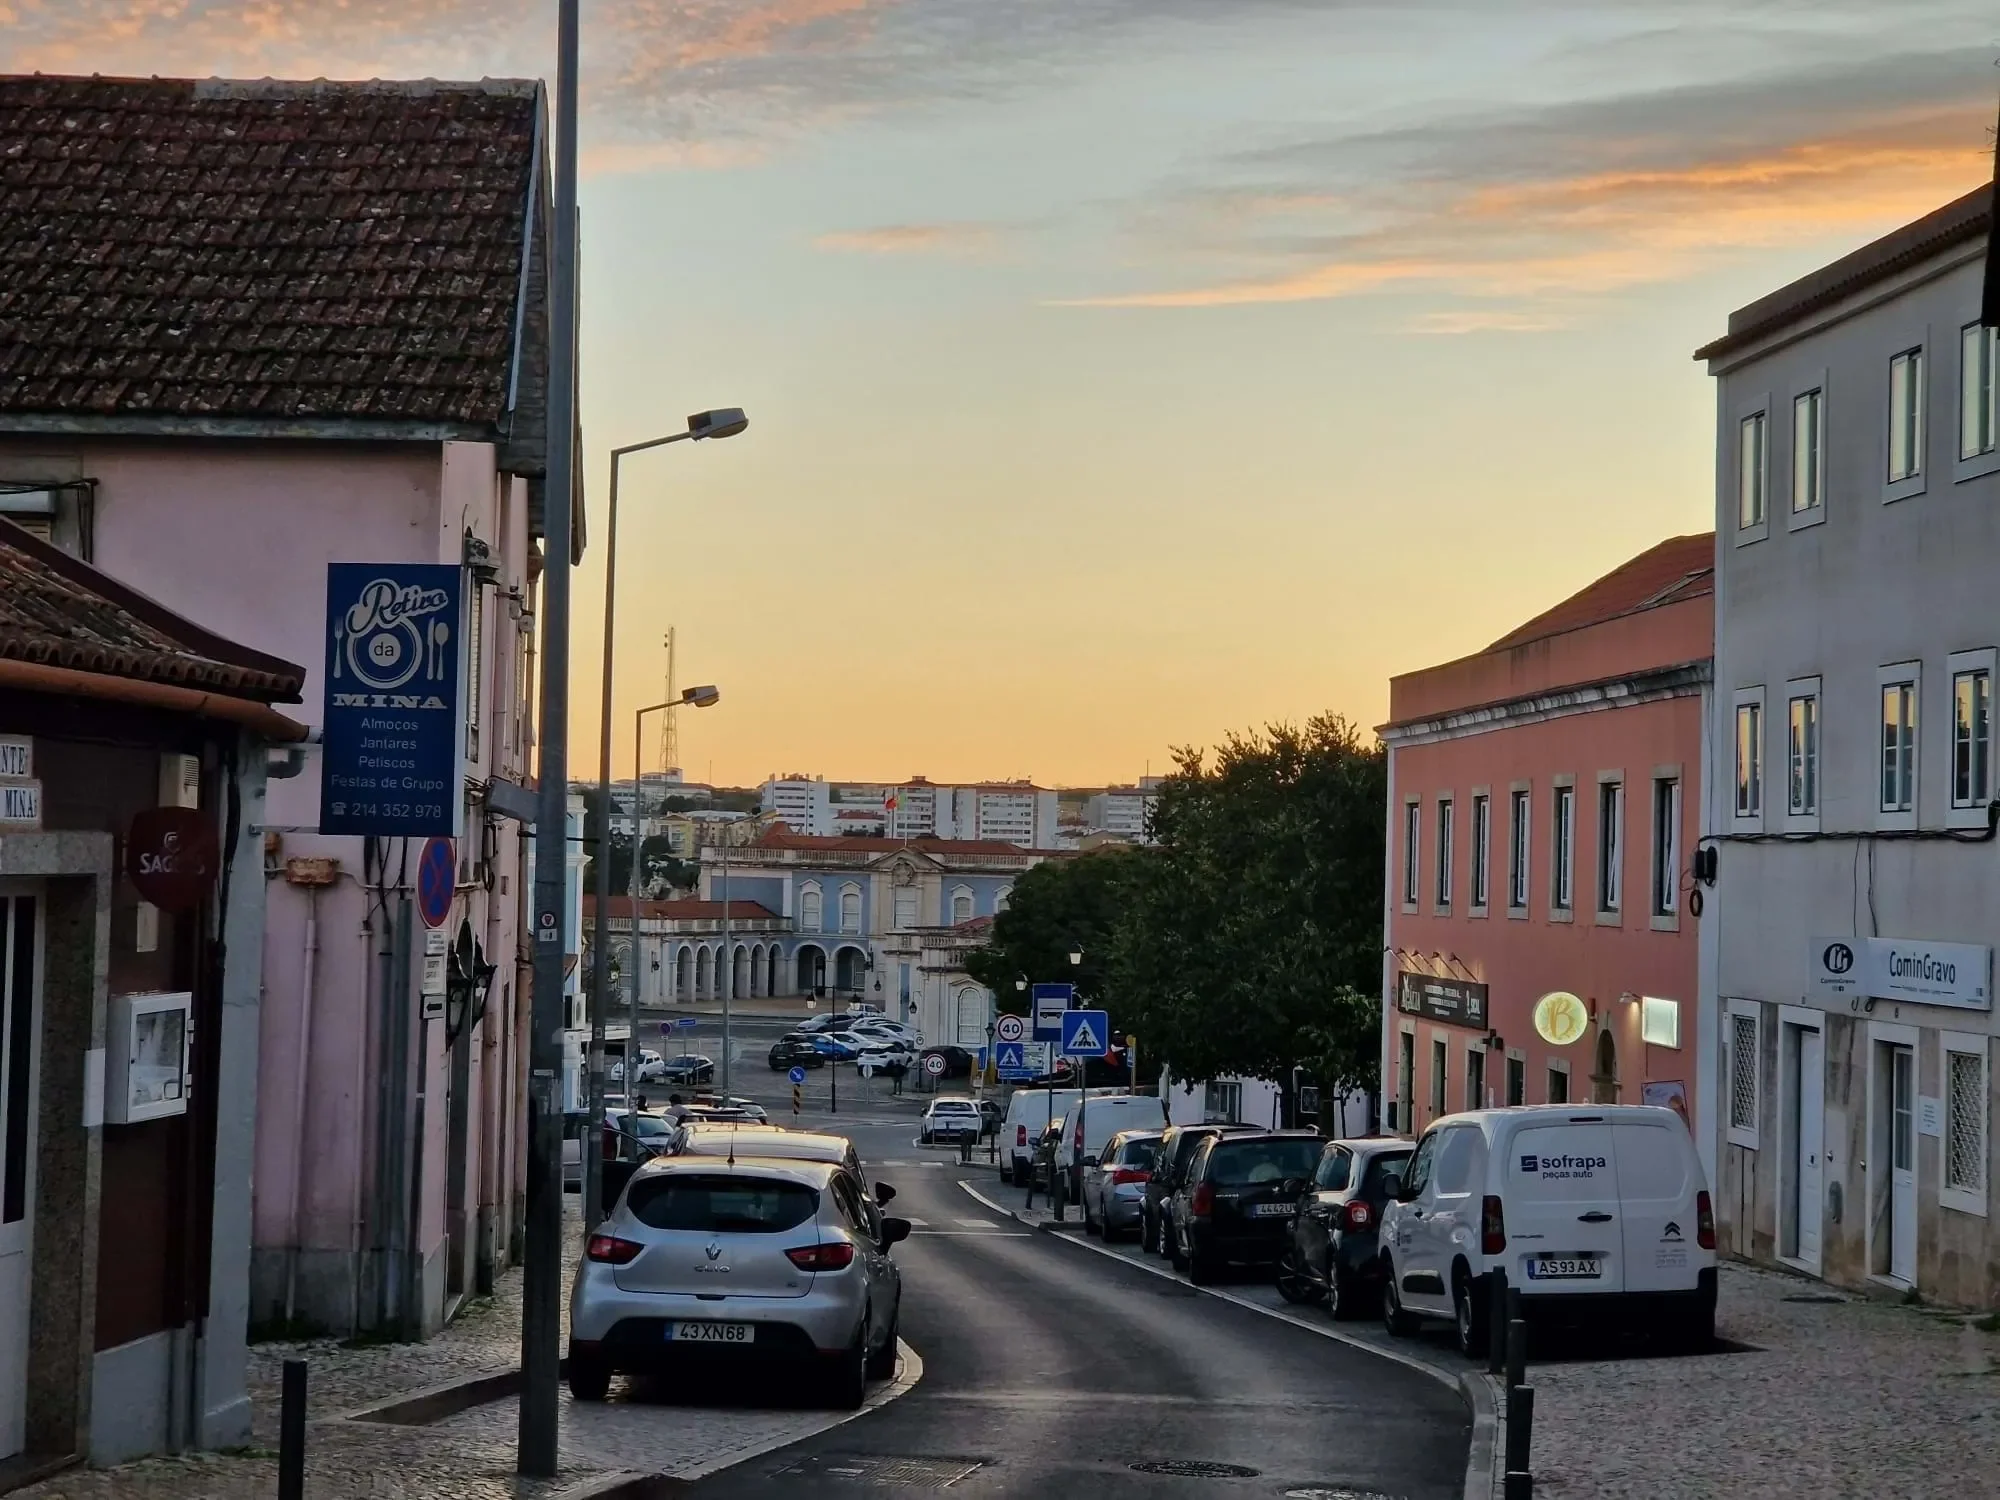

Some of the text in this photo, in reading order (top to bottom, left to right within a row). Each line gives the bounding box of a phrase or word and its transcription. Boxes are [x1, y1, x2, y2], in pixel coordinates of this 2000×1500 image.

[347, 581, 447, 634] Retiro
[373, 642, 395, 657] da
[332, 693, 448, 709] MINA
[361, 717, 419, 732] Almoços
[360, 736, 417, 750] Jantares
[358, 755, 415, 769] Petiscos
[331, 774, 444, 792] Festas de Grupo
[4, 788, 35, 818] MINA
[351, 802, 442, 819] 214 352 978
[1889, 950, 1956, 984] CominGravo
[1002, 1023, 1020, 1034] 40
[928, 1061, 943, 1069] 40
[1541, 1154, 1606, 1173] sofrapa
[1542, 1170, 1593, 1180] peças auto
[680, 1323, 746, 1341] 43XN68
